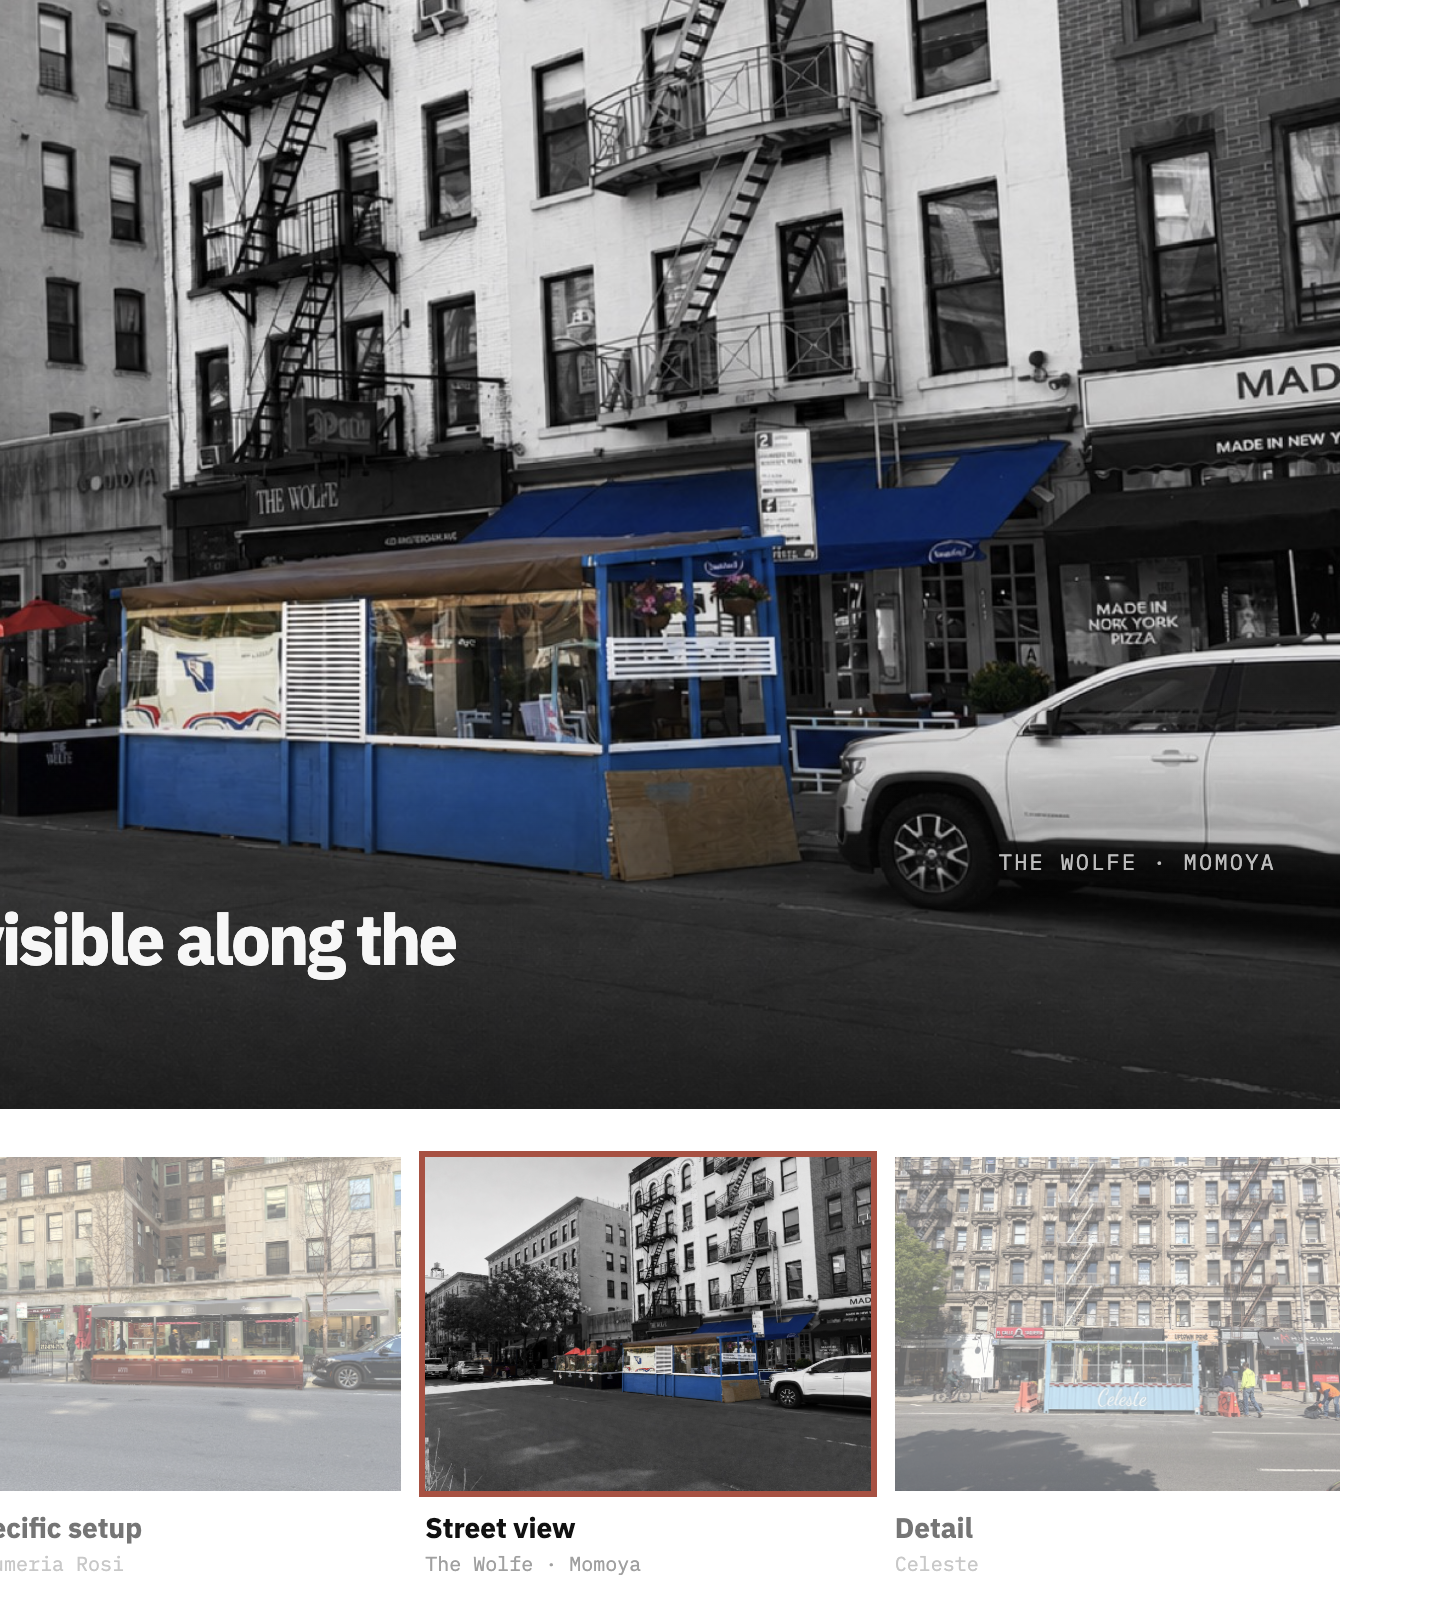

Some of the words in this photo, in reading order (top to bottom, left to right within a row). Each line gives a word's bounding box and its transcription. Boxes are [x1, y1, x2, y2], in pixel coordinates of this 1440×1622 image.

[1237, 363, 1340, 400] MAD
[759, 434, 769, 448] 2
[1216, 438, 1264, 454] MADE
[1267, 437, 1283, 450] IN
[1288, 432, 1325, 447] NEW
[256, 487, 285, 515] THE
[1096, 601, 1147, 616] MADE
[1150, 600, 1167, 614] IN
[1132, 615, 1178, 629] YORK
[1110, 631, 1157, 645] PIZZA
[1097, 1387, 1147, 1408] Celeste
